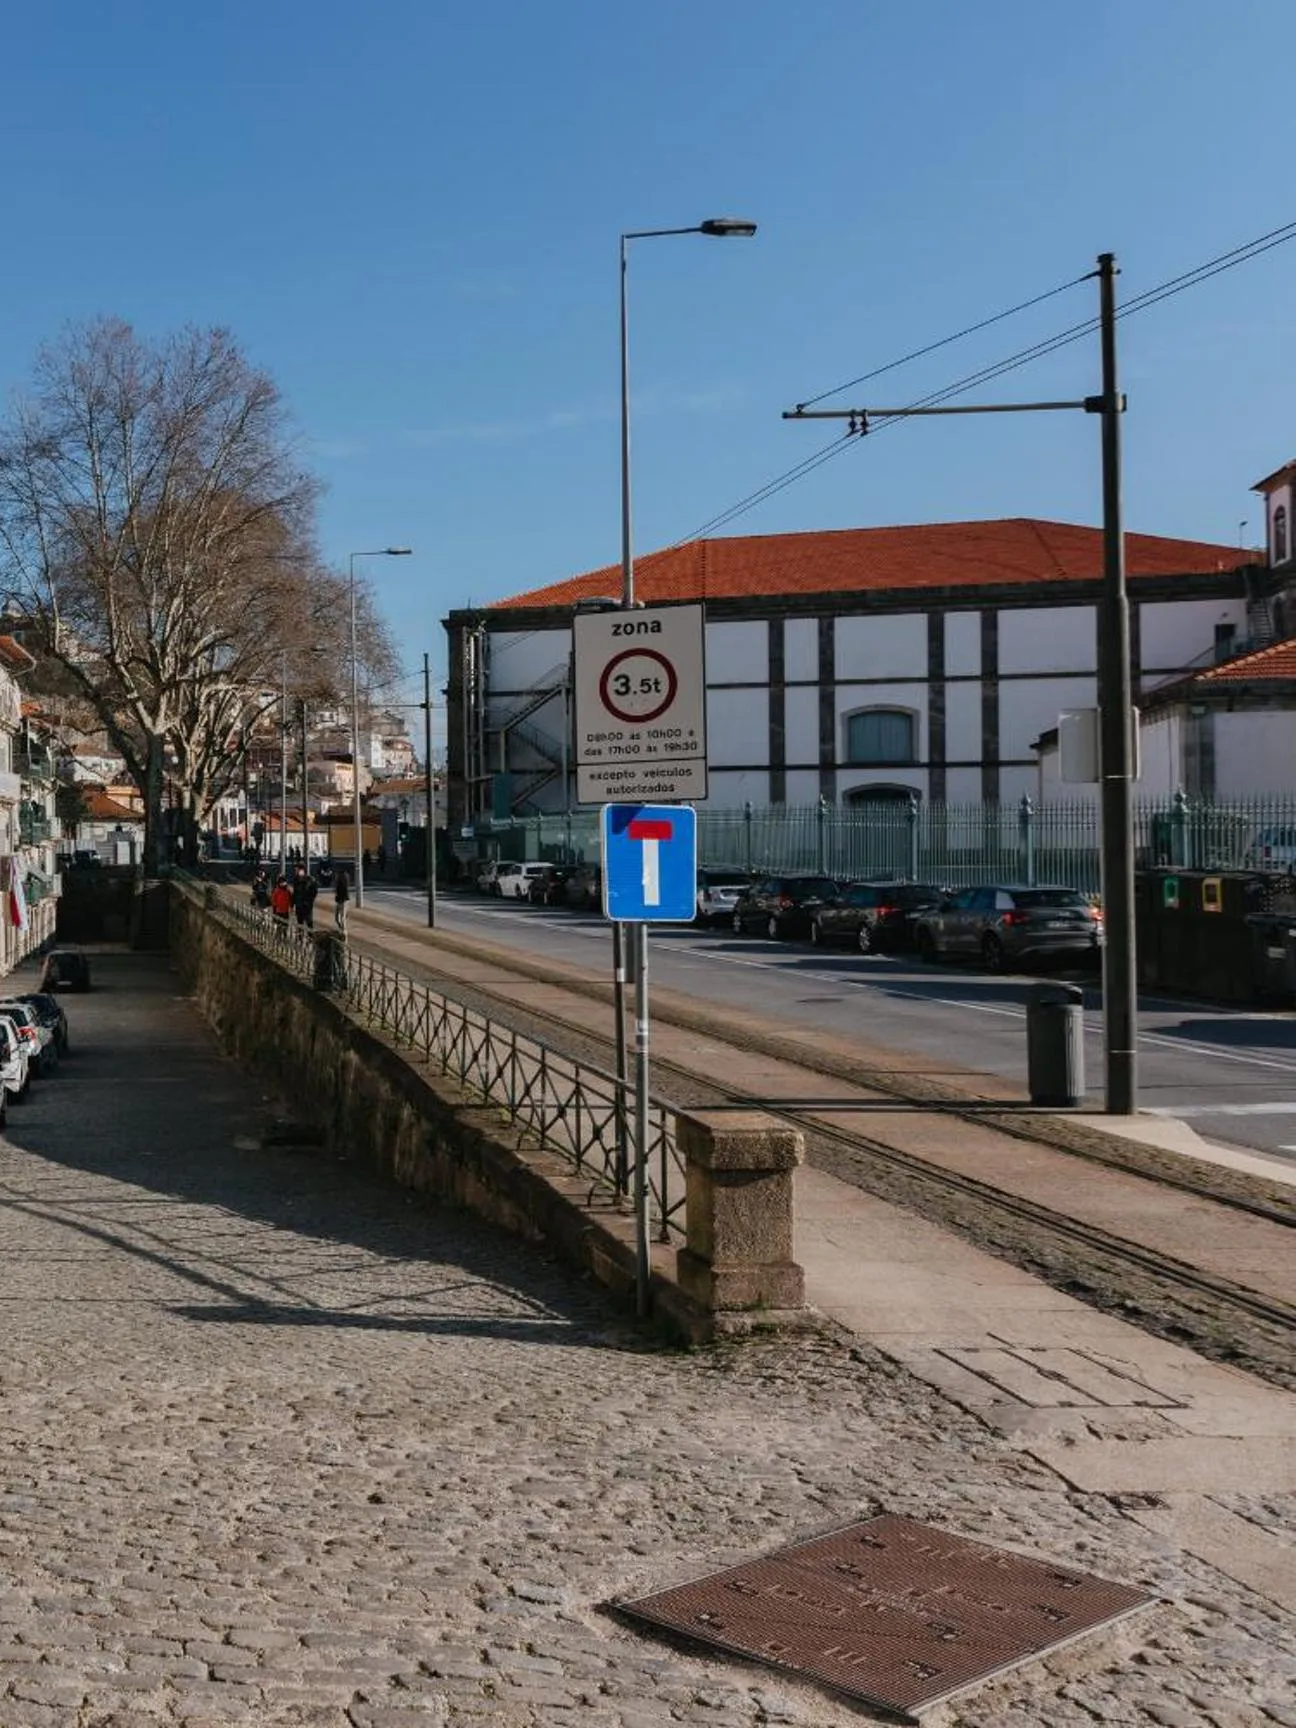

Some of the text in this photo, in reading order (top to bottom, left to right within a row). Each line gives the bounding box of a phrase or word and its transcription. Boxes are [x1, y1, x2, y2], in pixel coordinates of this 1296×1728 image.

[611, 620, 662, 636] zona
[613, 674, 662, 696] 3.5t
[608, 744, 640, 755] 17h00
[588, 769, 636, 781] excepto
[605, 782, 675, 795] autorizados
